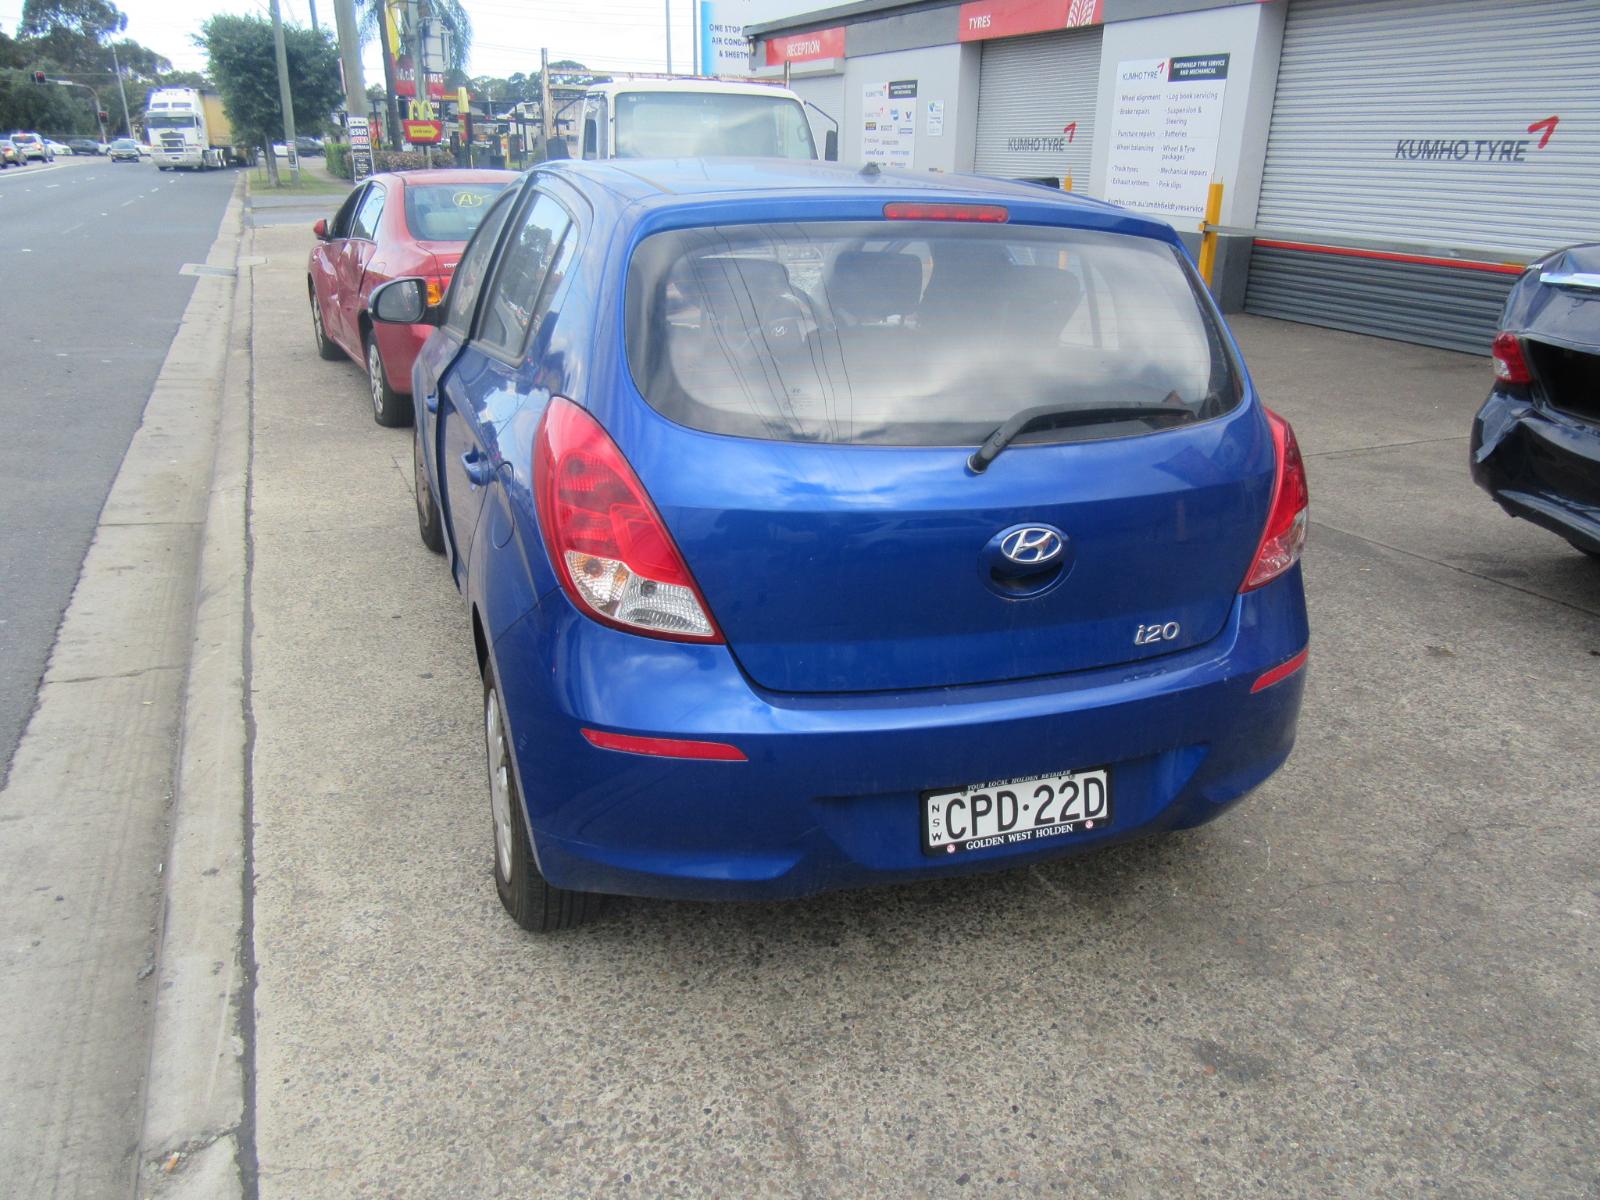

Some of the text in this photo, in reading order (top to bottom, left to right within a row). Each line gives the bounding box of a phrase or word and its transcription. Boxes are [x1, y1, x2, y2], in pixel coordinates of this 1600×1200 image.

[709, 24, 741, 34] ONE STOP
[969, 15, 991, 30] TYRES
[712, 37, 723, 45] AIR
[786, 40, 821, 57] RECEPTION
[1122, 71, 1158, 80] KUMHO TYRE
[1169, 91, 1218, 101] Log book servicing
[1008, 136, 1065, 152] KUMHO TYRE
[1395, 140, 1530, 162] KUMHO TYRE
[1134, 621, 1181, 646] i20
[967, 769, 1072, 791] YOUR LOCAL HOLDEN RETAILER
[966, 823, 1074, 850] GOLDEN WEST HOLDEN
